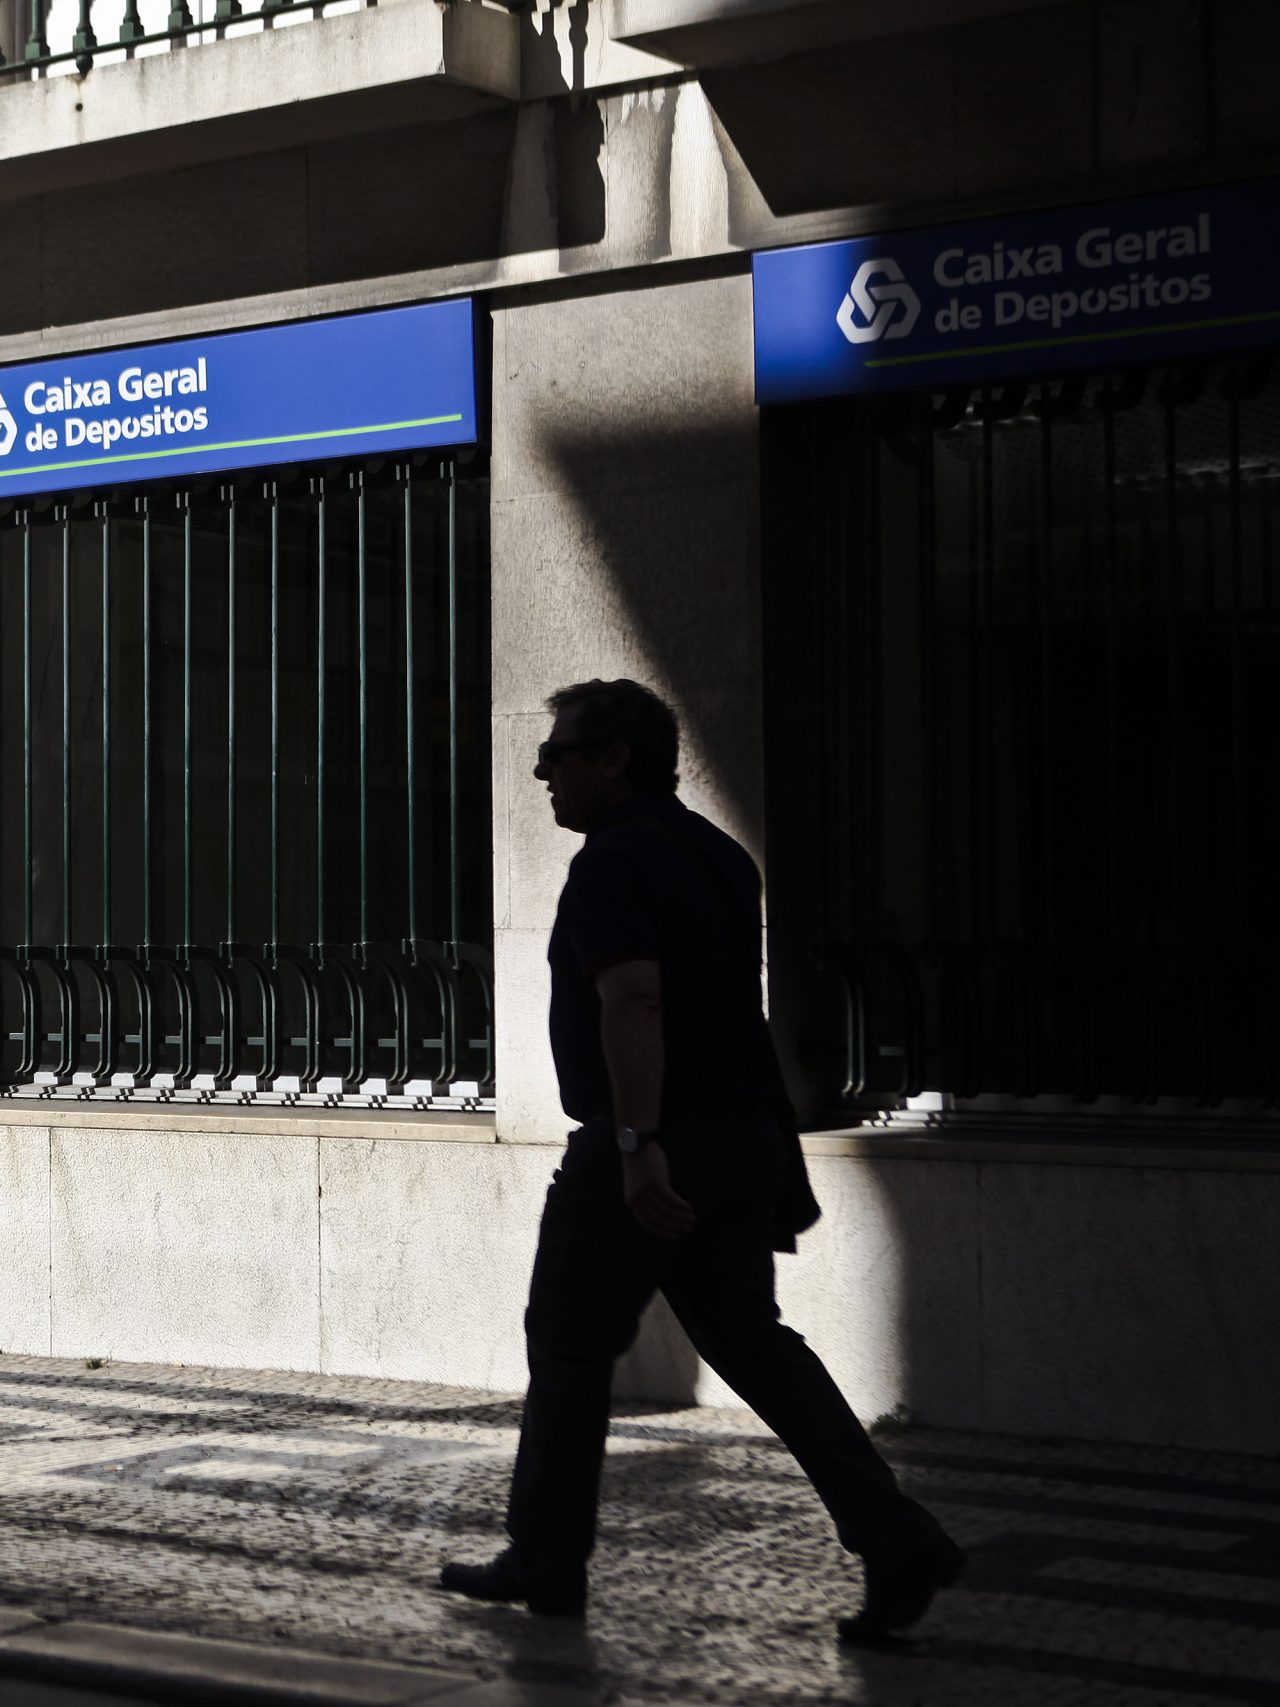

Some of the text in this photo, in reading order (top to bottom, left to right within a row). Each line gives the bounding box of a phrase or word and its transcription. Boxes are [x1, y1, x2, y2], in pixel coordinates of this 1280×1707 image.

[932, 212, 1211, 287] Caixa Geral
[933, 299, 982, 333] de
[24, 357, 207, 415] Caixa Geral
[25, 422, 58, 452] de
